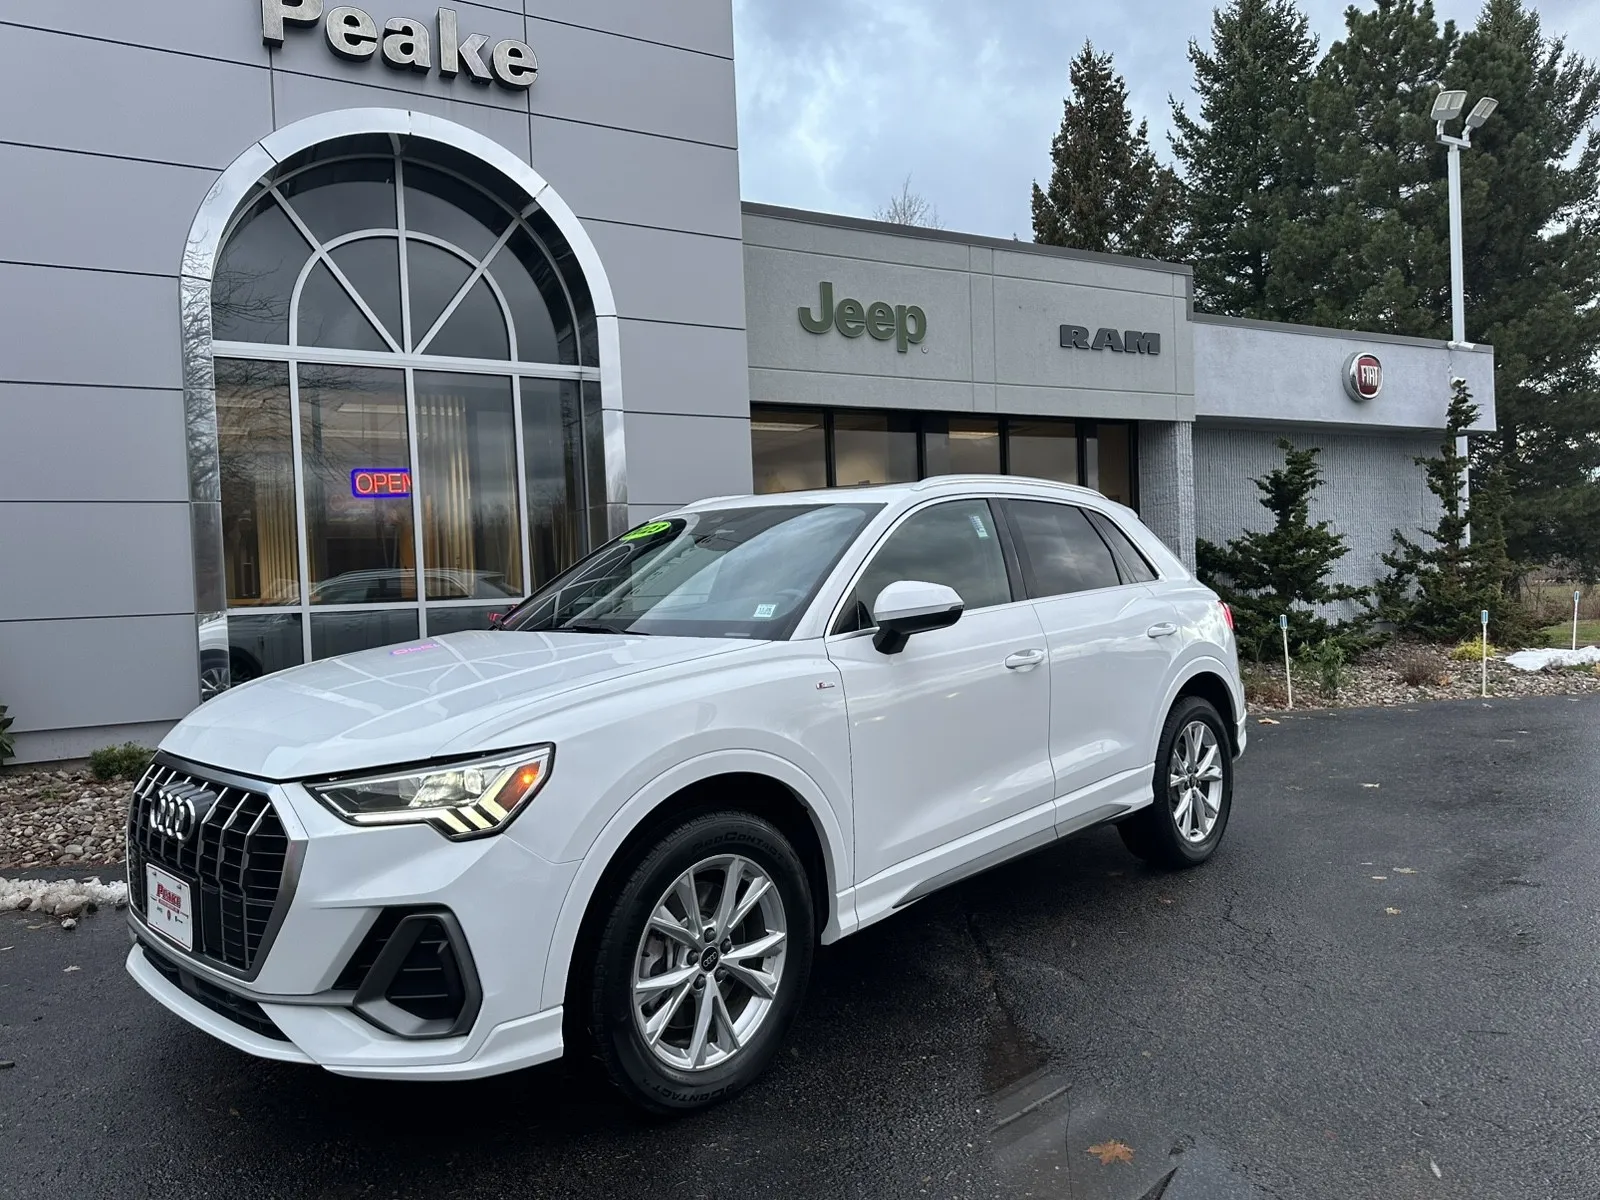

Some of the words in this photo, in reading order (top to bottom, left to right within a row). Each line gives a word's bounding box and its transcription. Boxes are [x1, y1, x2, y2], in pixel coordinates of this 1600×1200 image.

[262, 0, 539, 90] Peake
[798, 281, 927, 353] Jeep
[1060, 324, 1161, 355] RAM
[1361, 365, 1379, 386] FIAT
